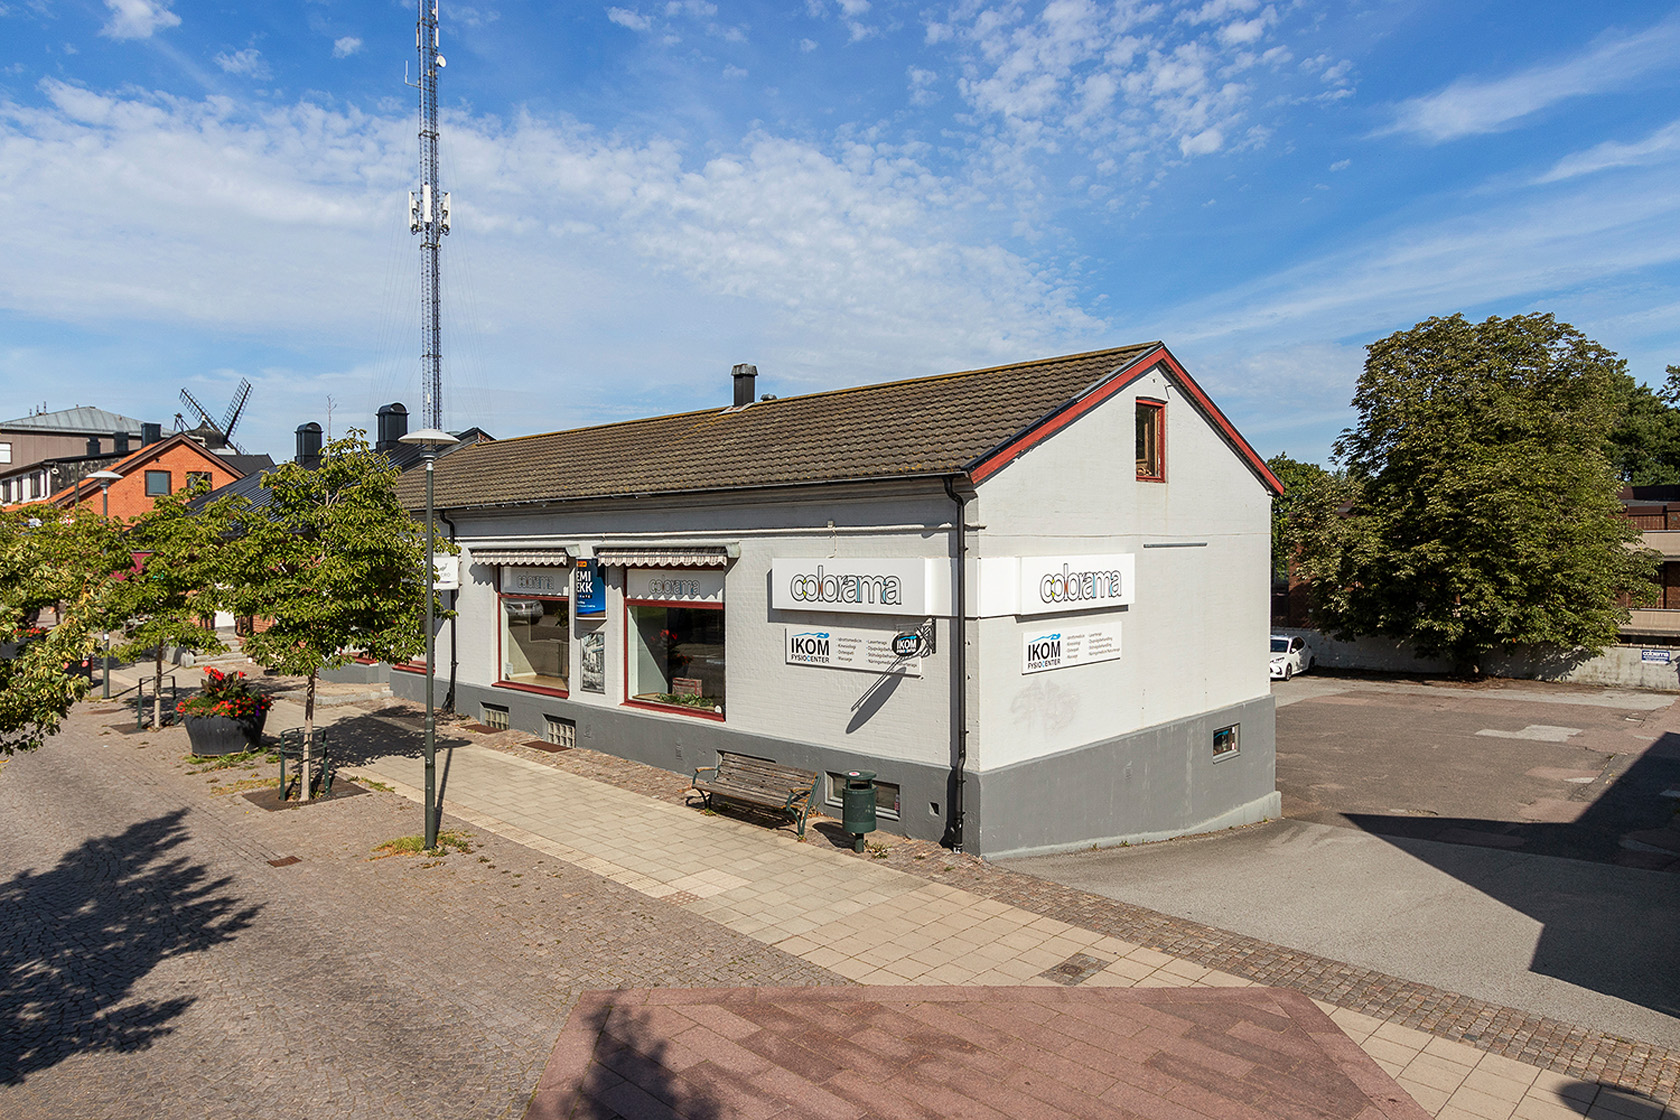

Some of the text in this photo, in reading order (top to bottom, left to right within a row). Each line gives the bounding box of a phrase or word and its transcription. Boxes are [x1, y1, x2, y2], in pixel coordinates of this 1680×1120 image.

[577, 571, 591, 581] EMI
[1040, 563, 1122, 604] colorama
[577, 582, 593, 593] EKK
[648, 574, 700, 596] colorama
[790, 565, 902, 605] colorama
[791, 637, 830, 656] IKOM
[896, 639, 917, 650] IKOM
[1028, 641, 1061, 662] IKOM
[791, 654, 830, 664] FYSIOCENTER
[1028, 658, 1061, 670] FYSIOCENTER
